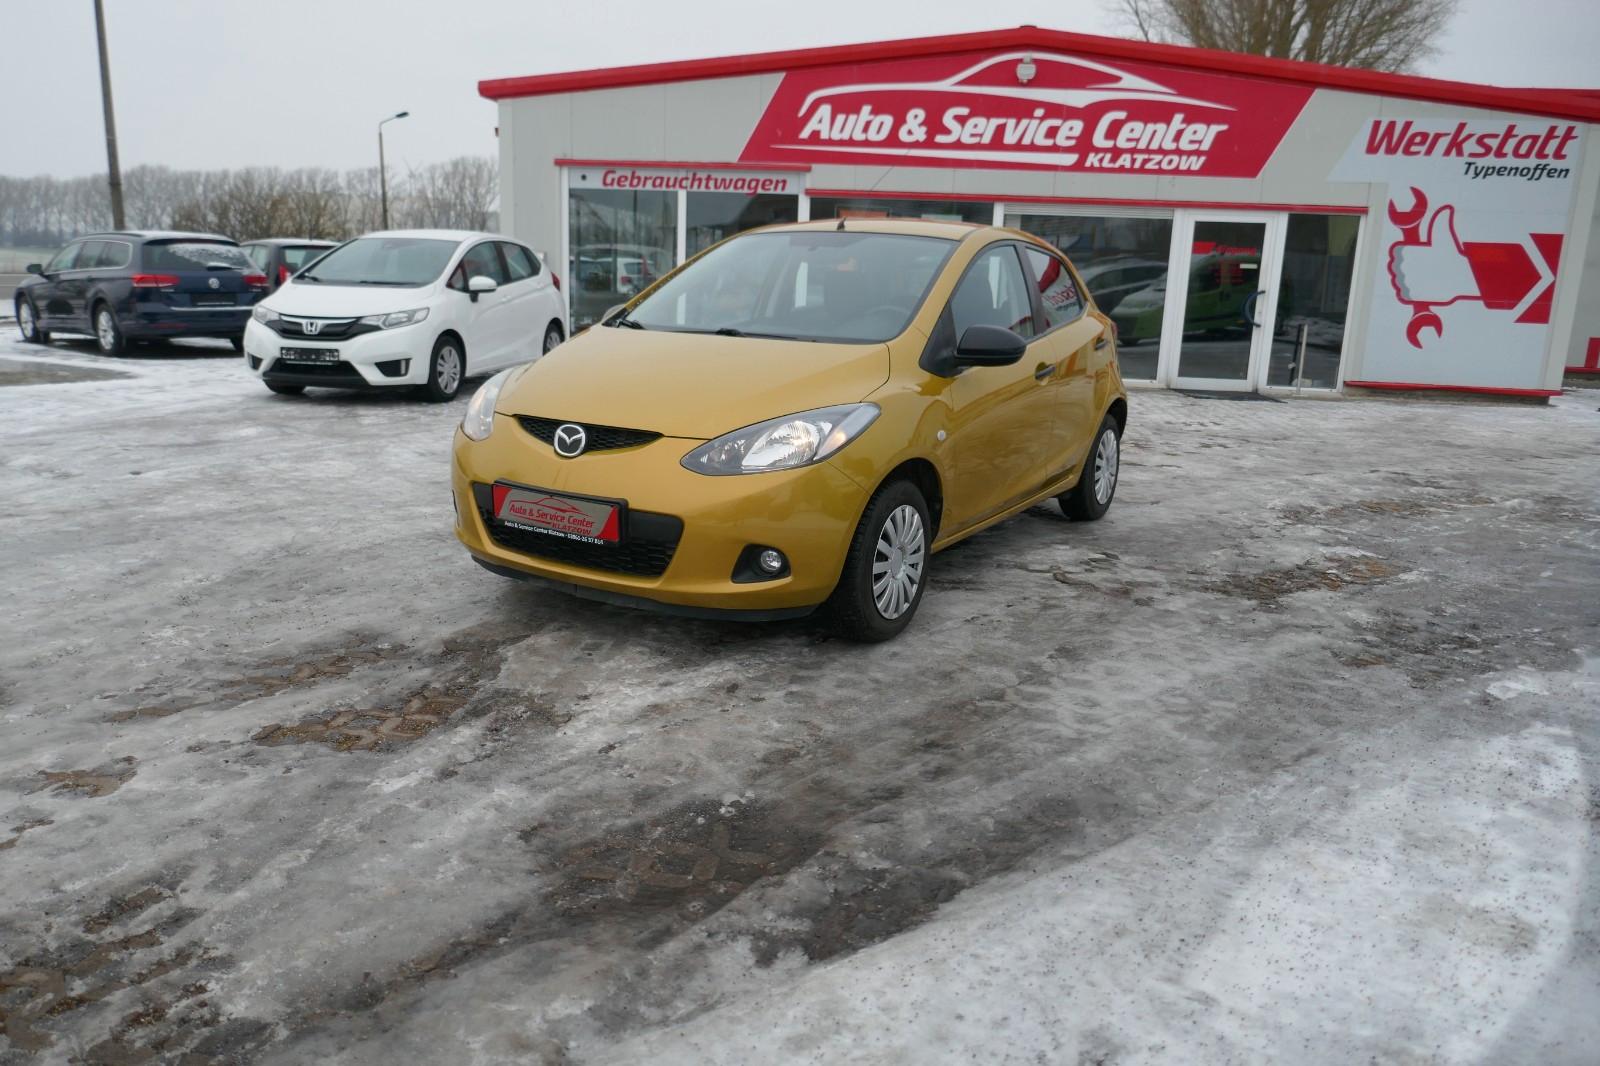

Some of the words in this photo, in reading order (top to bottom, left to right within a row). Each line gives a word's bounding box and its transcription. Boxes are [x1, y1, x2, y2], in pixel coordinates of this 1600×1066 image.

[799, 104, 893, 142] Auto
[899, 108, 927, 143] &
[934, 106, 1084, 148] Service
[1091, 111, 1229, 151] Center
[1365, 119, 1578, 160] Werkstatt
[1085, 152, 1206, 171] KLATZOW
[1463, 161, 1570, 181] Typenoffen
[602, 170, 787, 196] Gebrauchtwagen
[510, 504, 526, 516] Auto
[528, 508, 534, 517] &
[536, 509, 566, 522] Service
[567, 515, 596, 528] Center
[551, 522, 592, 535] KLATZOW
